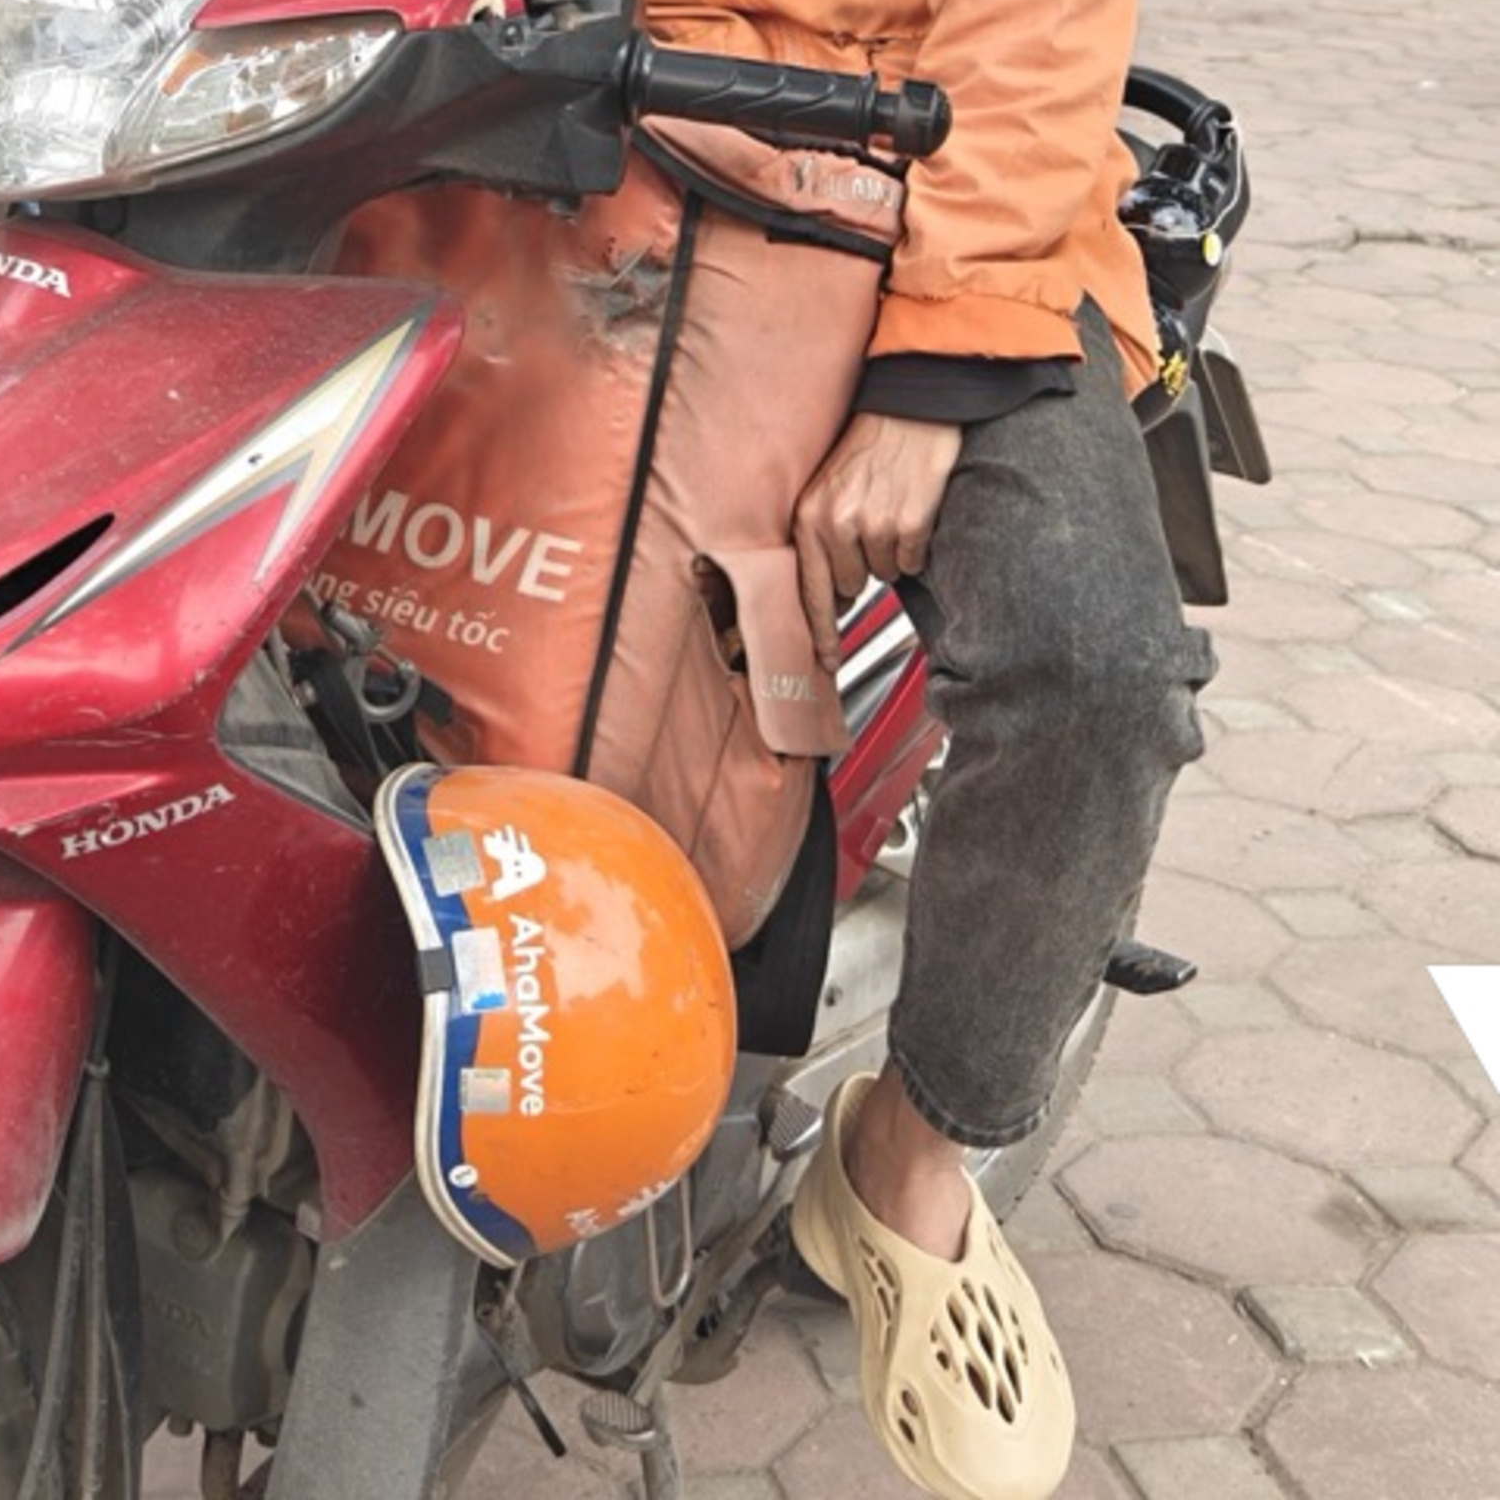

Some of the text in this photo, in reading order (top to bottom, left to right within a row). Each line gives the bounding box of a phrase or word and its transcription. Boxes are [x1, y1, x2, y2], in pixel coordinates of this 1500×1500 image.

[339, 489, 583, 603] MOVE
[306, 568, 512, 654] ng siêu tốc
[60, 782, 237, 861] HONDA
[507, 912, 552, 1118] AhaMove
